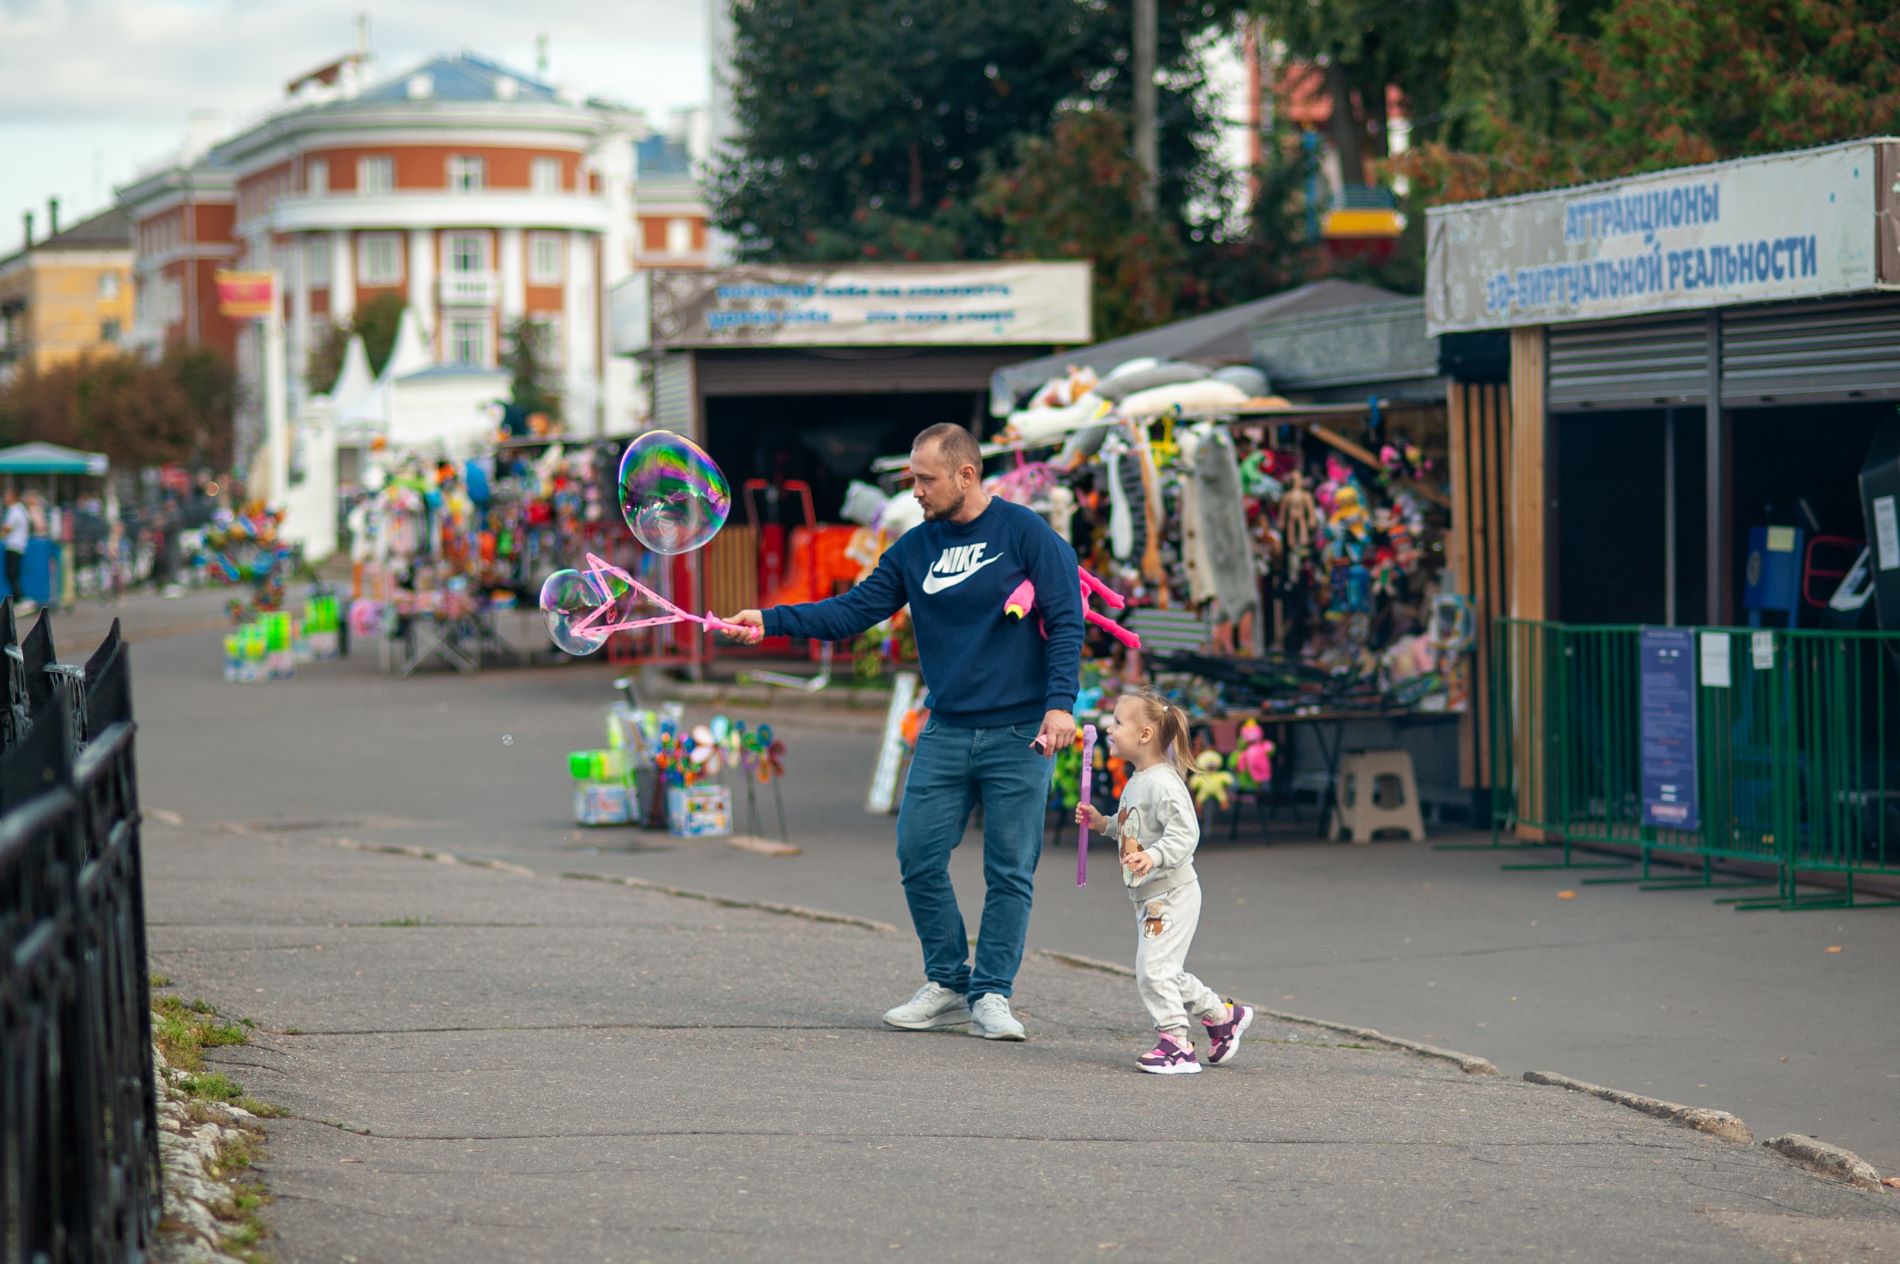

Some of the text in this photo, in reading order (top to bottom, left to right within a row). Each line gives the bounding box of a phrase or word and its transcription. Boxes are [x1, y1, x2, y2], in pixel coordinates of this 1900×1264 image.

[1564, 183, 1720, 245] АТТРАКЦИОНЫ
[1667, 234, 1817, 291] РЕАЛЬНОСТИ
[932, 542, 987, 574] NIKE
